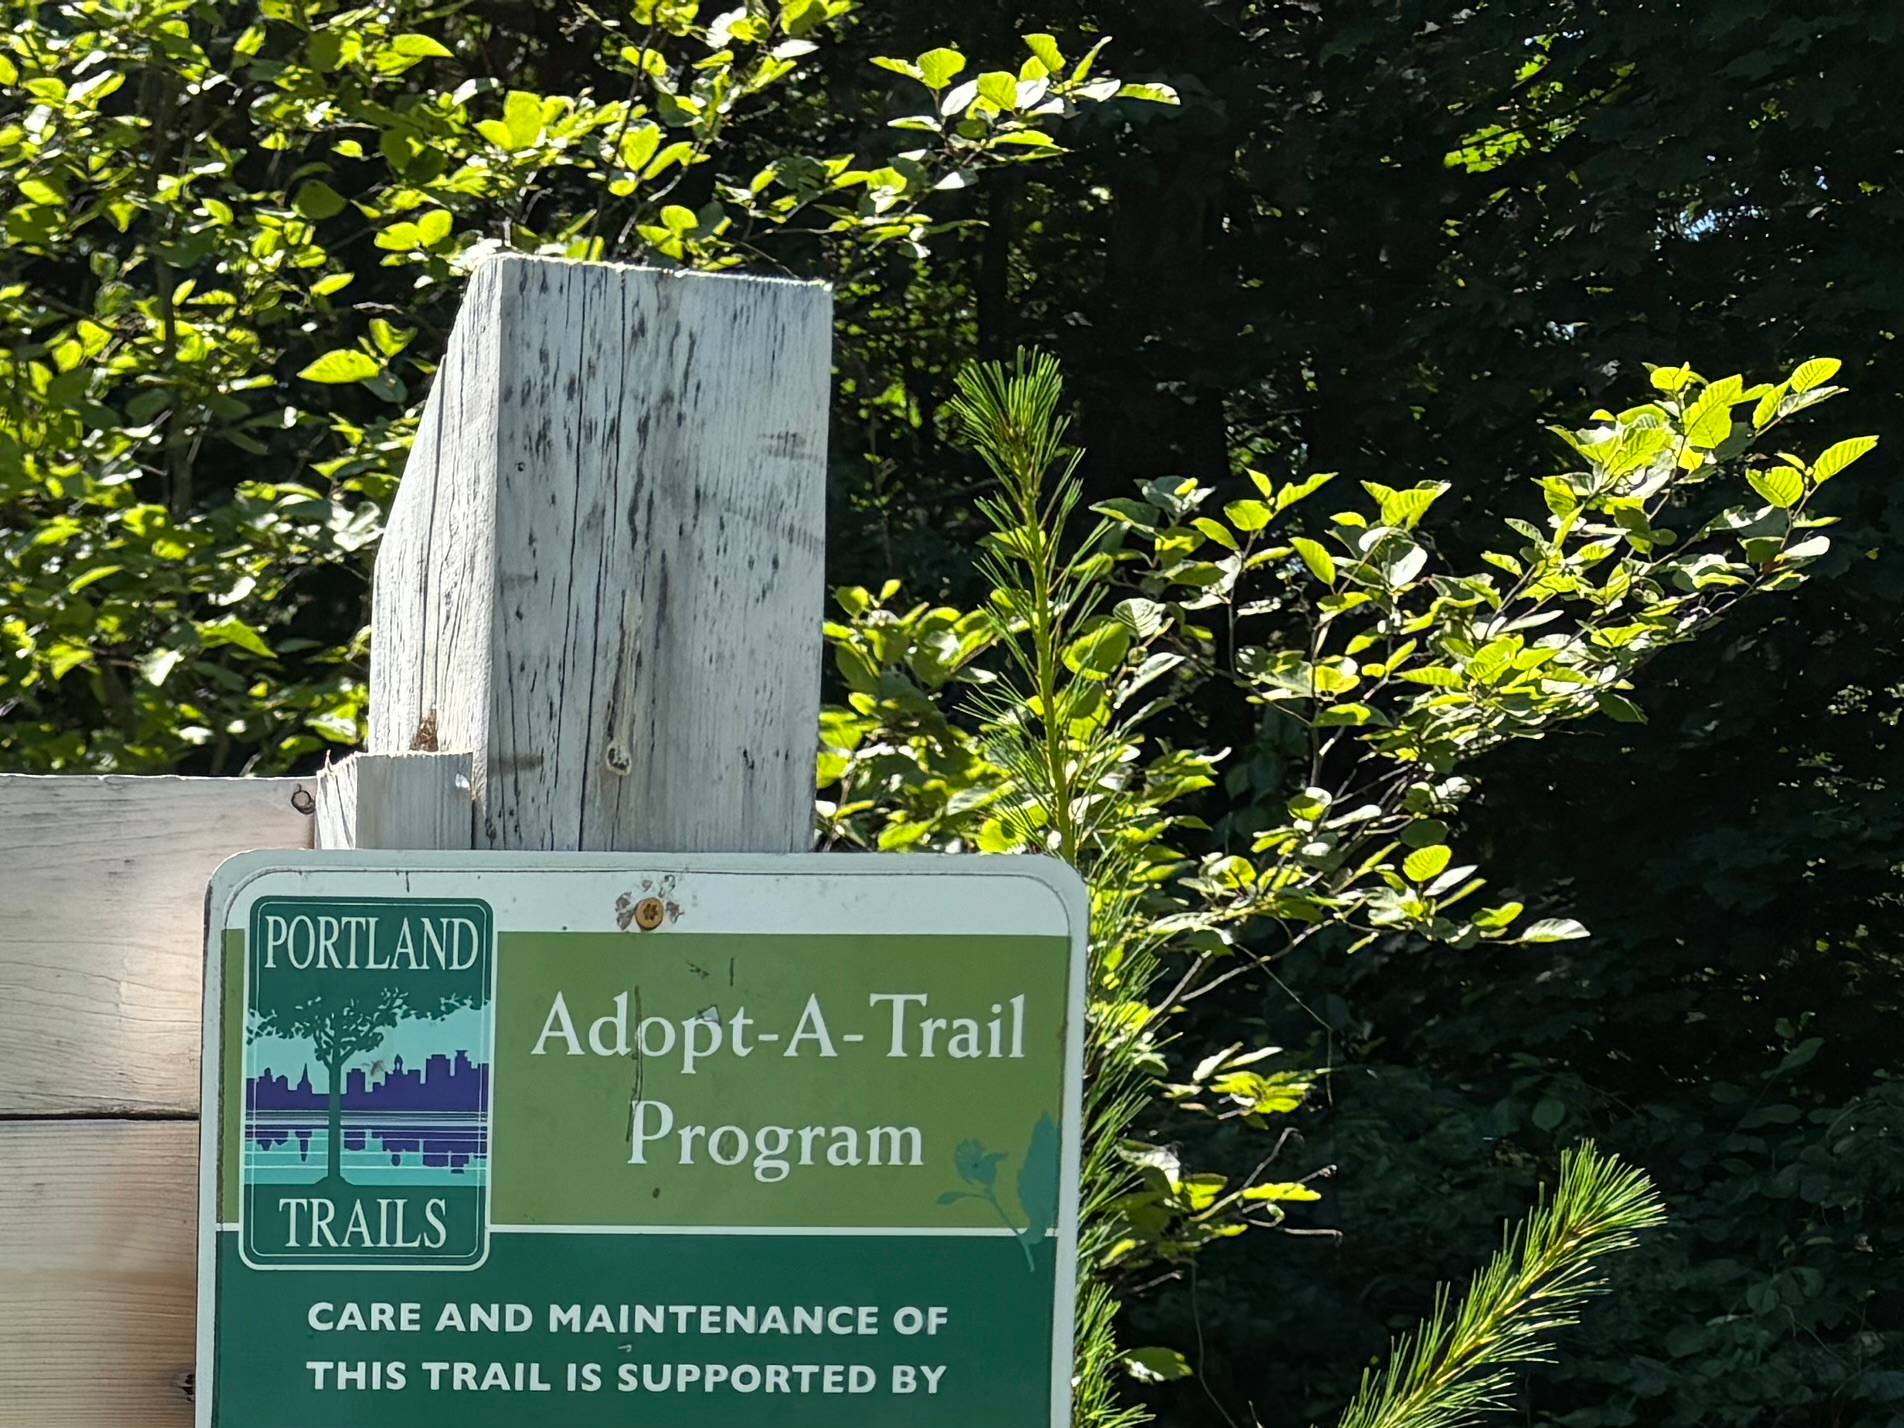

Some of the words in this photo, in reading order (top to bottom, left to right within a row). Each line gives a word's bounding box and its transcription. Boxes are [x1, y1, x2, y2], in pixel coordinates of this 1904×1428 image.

[264, 913, 479, 973] PORTLAND
[530, 989, 1027, 1076] Adopt-A-Trail
[626, 1098, 927, 1184] Program
[279, 1197, 448, 1251] TRAILS
[306, 1301, 423, 1333] CARE
[434, 1302, 534, 1334] AND
[548, 1303, 881, 1335] MAINTENANCE
[893, 1305, 949, 1336] OF
[306, 1361, 409, 1392] THIS
[421, 1361, 551, 1393] TRAIL
[566, 1362, 603, 1393] IS
[615, 1362, 877, 1395] SUPPORTED
[891, 1364, 949, 1395] BY
